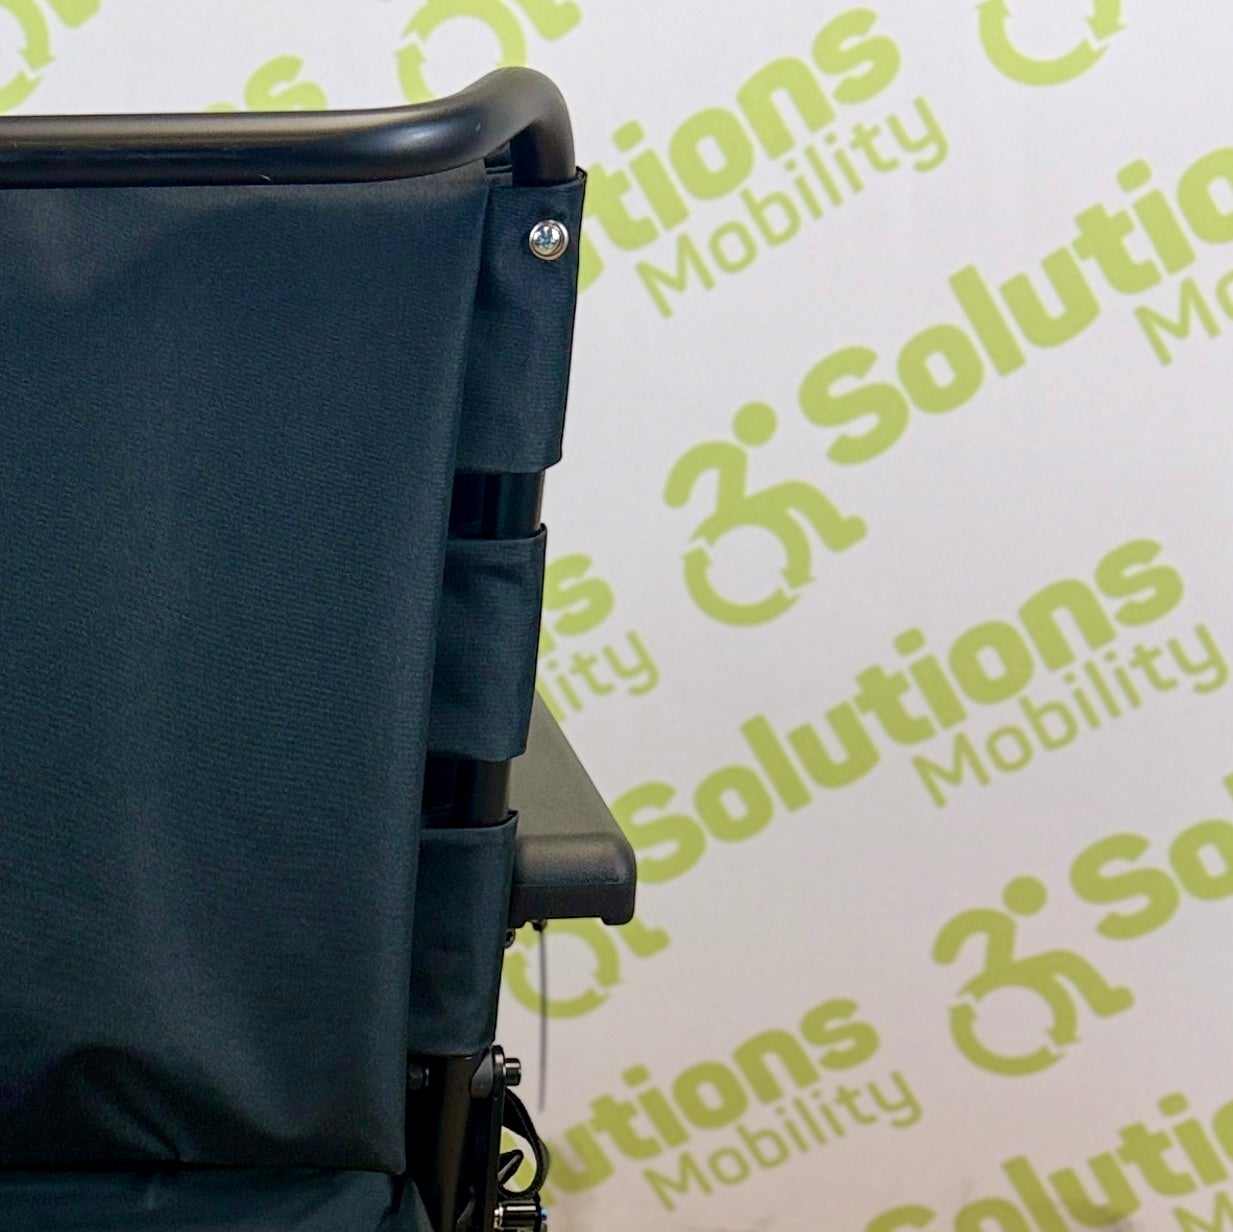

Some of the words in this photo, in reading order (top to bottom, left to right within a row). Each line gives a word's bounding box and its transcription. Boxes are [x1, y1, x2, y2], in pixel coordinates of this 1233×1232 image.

[635, 96, 950, 319] Mobility
[609, 538, 1185, 884] Solutions
[910, 622, 1231, 809] Mobility
[500, 996, 882, 1207] utions
[642, 1070, 924, 1212] Mobility
